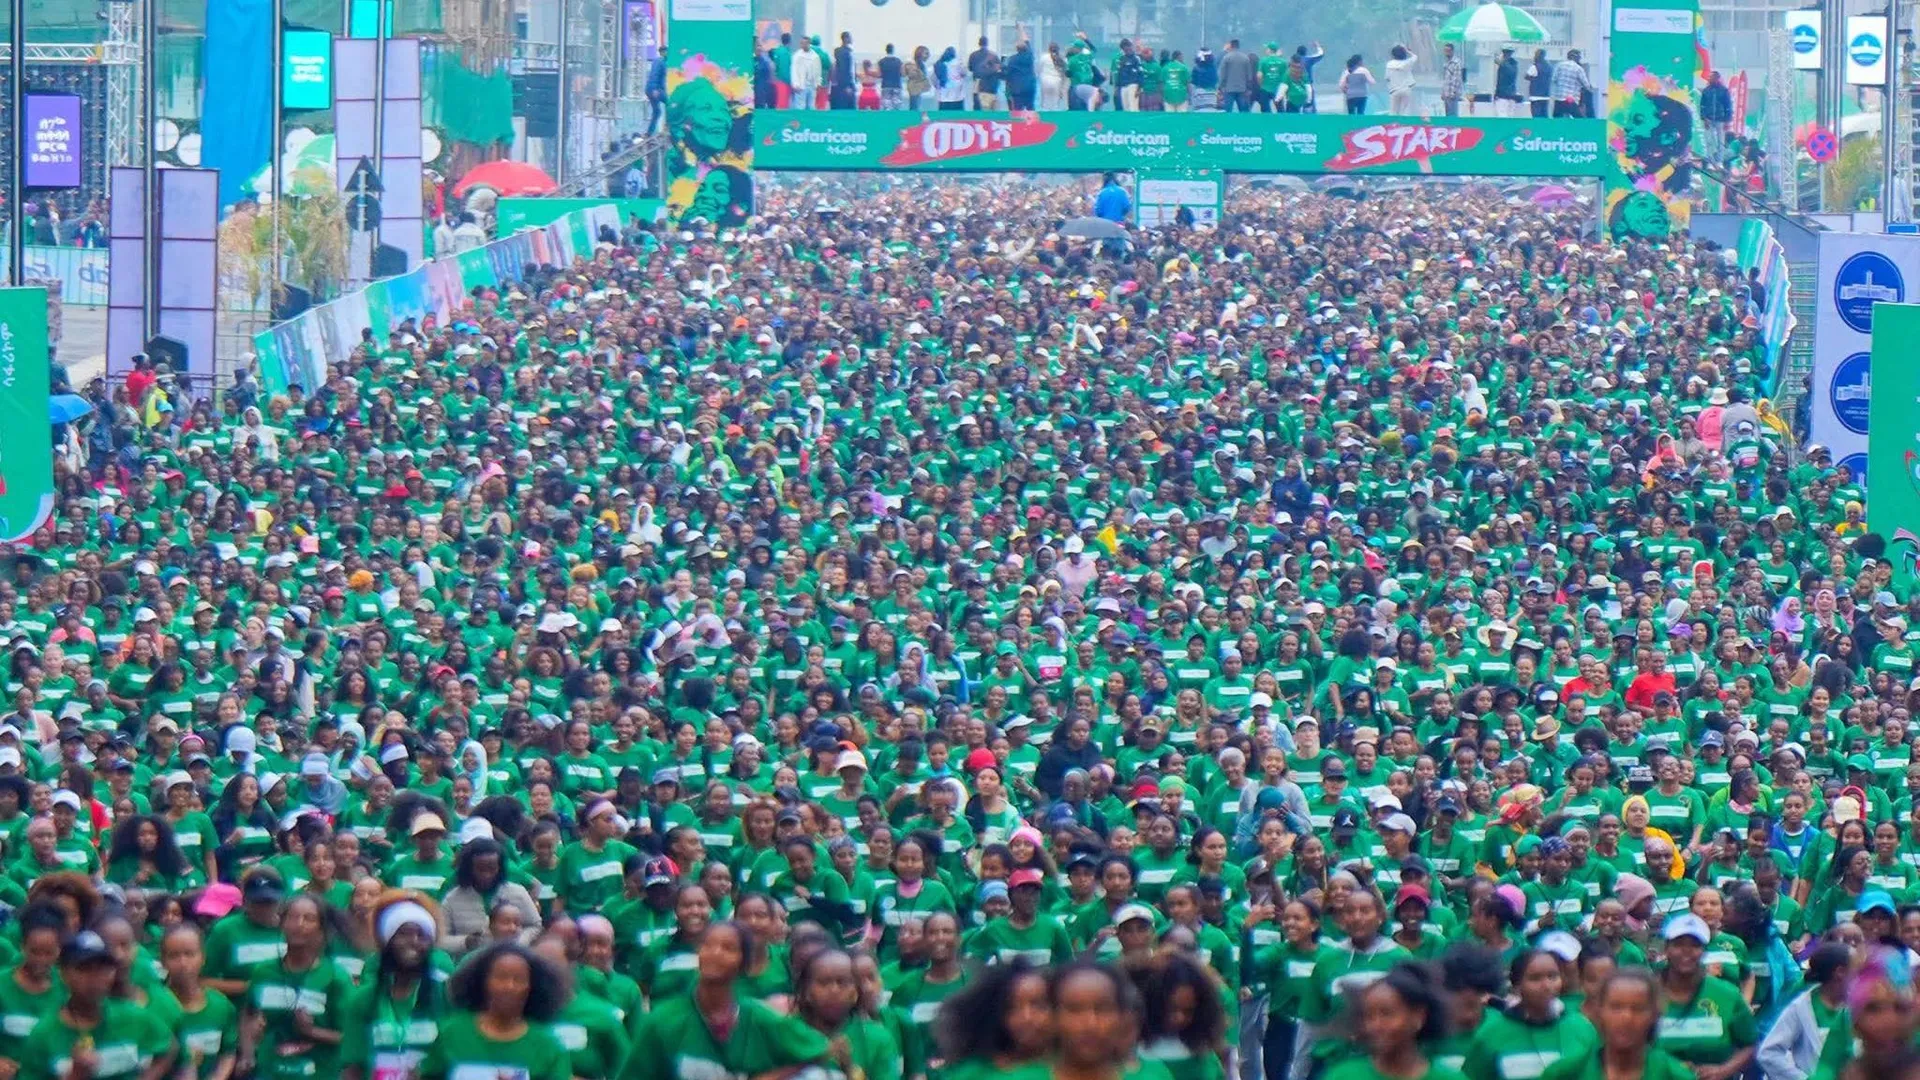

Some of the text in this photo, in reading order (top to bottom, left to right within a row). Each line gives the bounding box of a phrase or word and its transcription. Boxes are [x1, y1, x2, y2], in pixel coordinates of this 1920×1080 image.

[782, 128, 867, 143] Safaricom
[923, 121, 1012, 158] መነሻ
[1085, 130, 1170, 145] Safaricom
[1200, 133, 1263, 145] Safaricom
[1275, 133, 1317, 143] WOMEN
[1350, 125, 1461, 163] START
[1513, 136, 1597, 151] Safaricom
